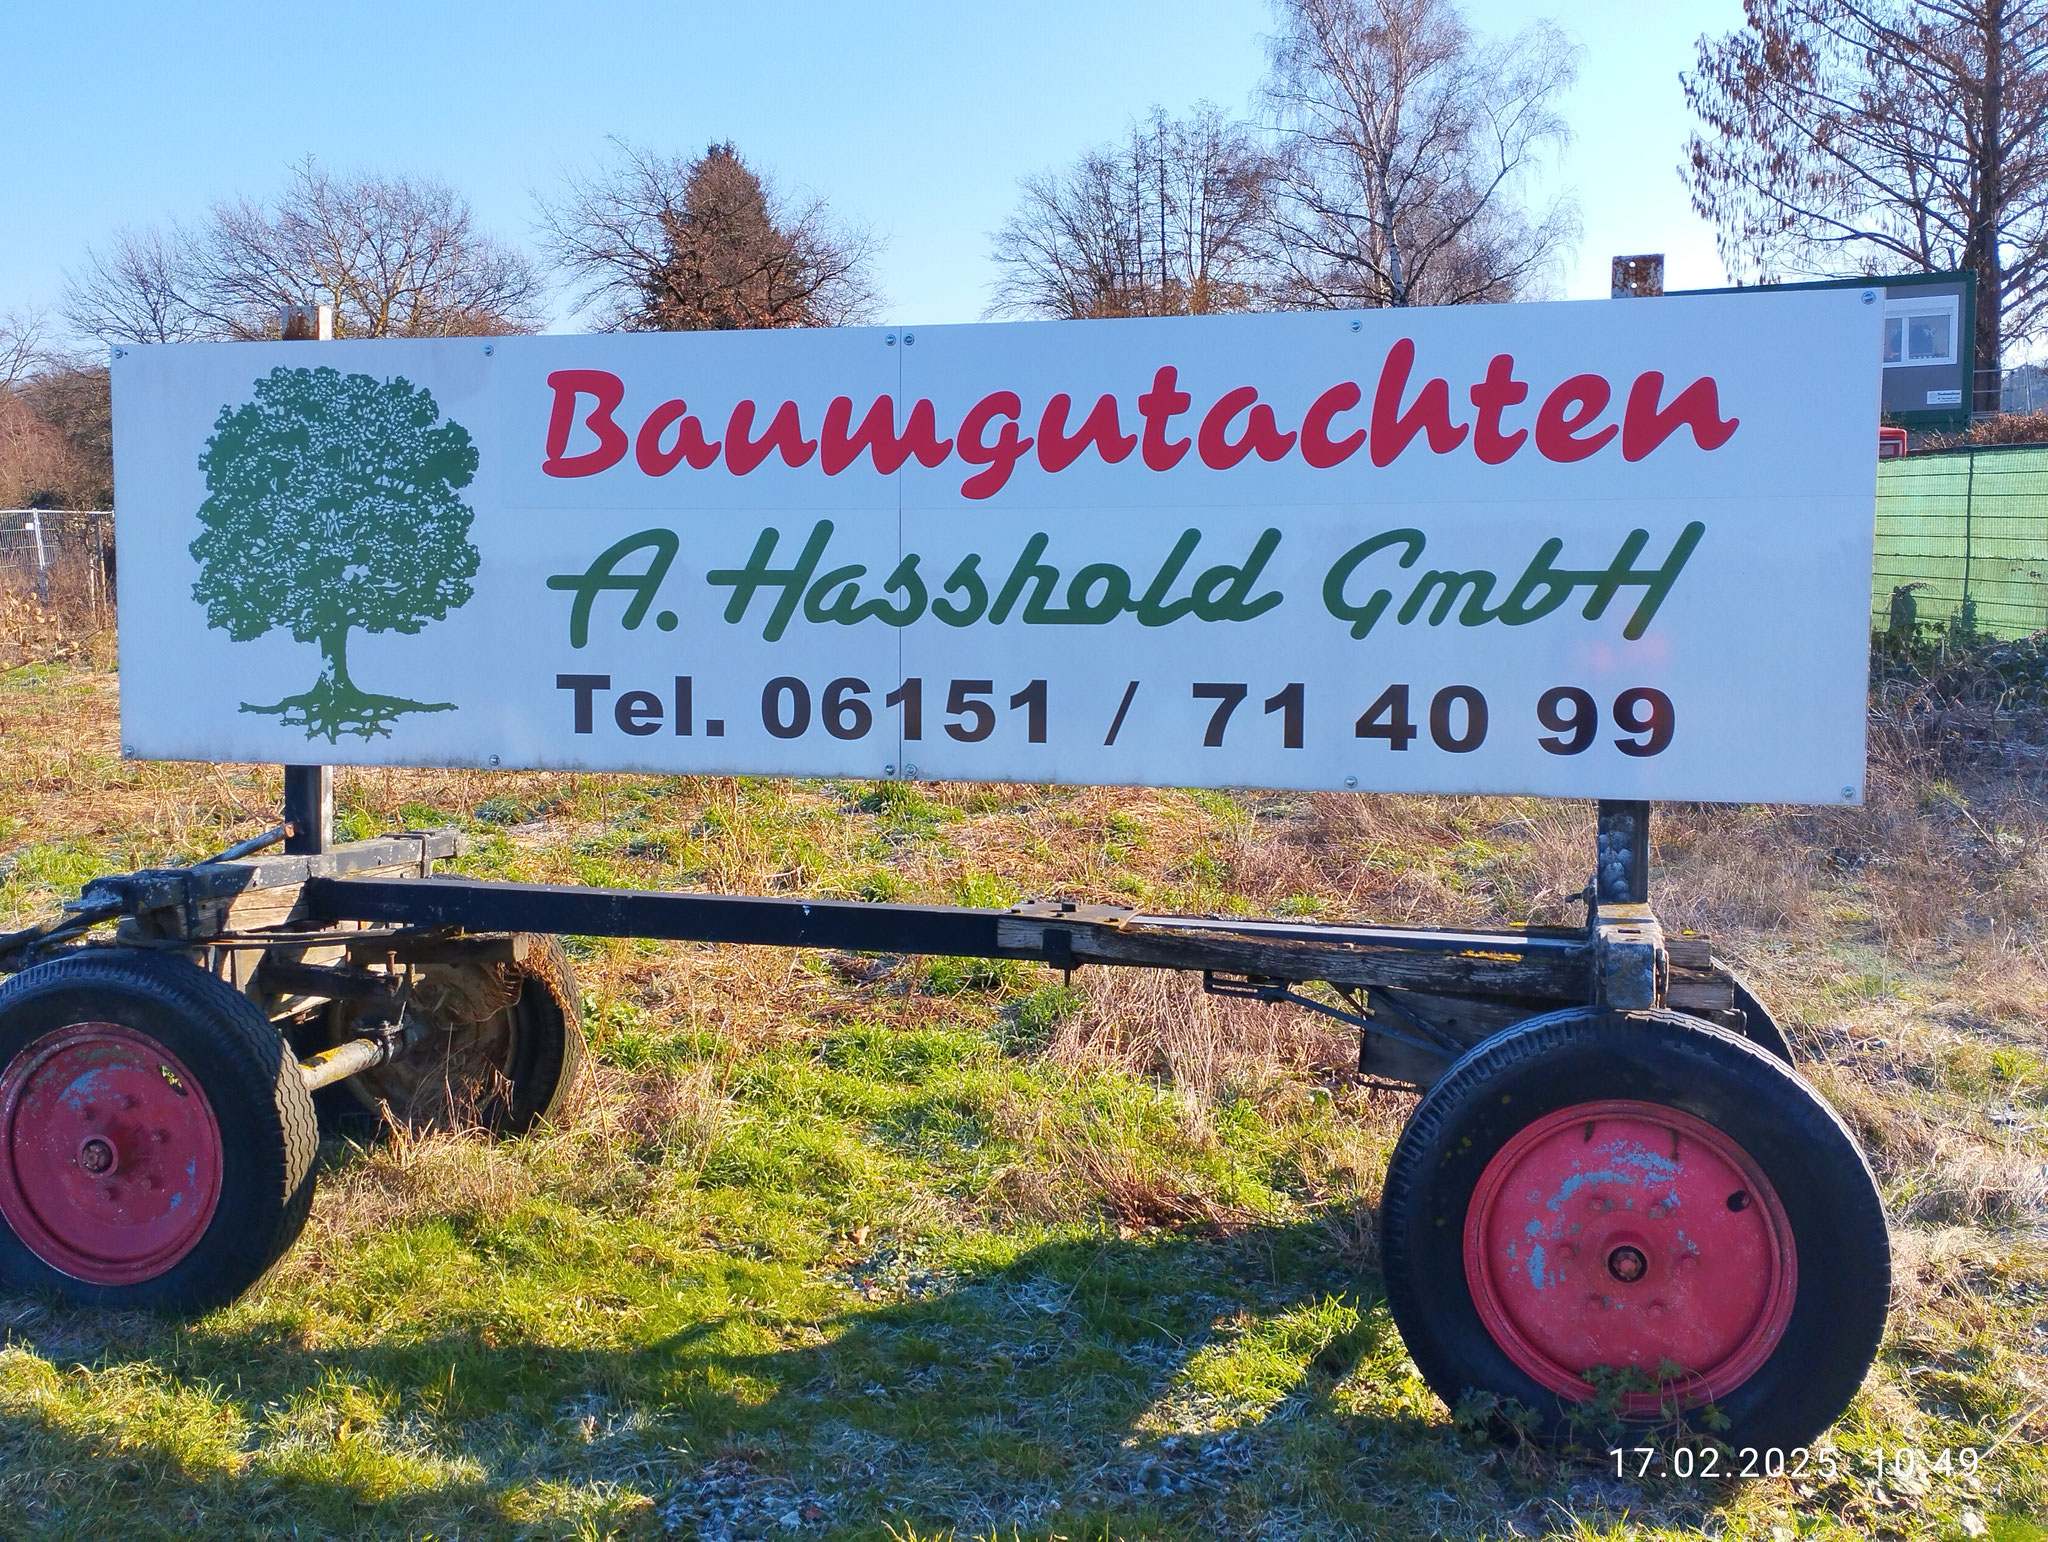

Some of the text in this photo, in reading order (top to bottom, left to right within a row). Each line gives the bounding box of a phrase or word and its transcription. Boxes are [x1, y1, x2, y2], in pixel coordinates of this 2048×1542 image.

[543, 338, 1740, 500] Baumgutachten
[546, 519, 1705, 649] A. Hasshold GmbH
[556, 675, 1674, 757] Tel. 06151 / 71 40 99
